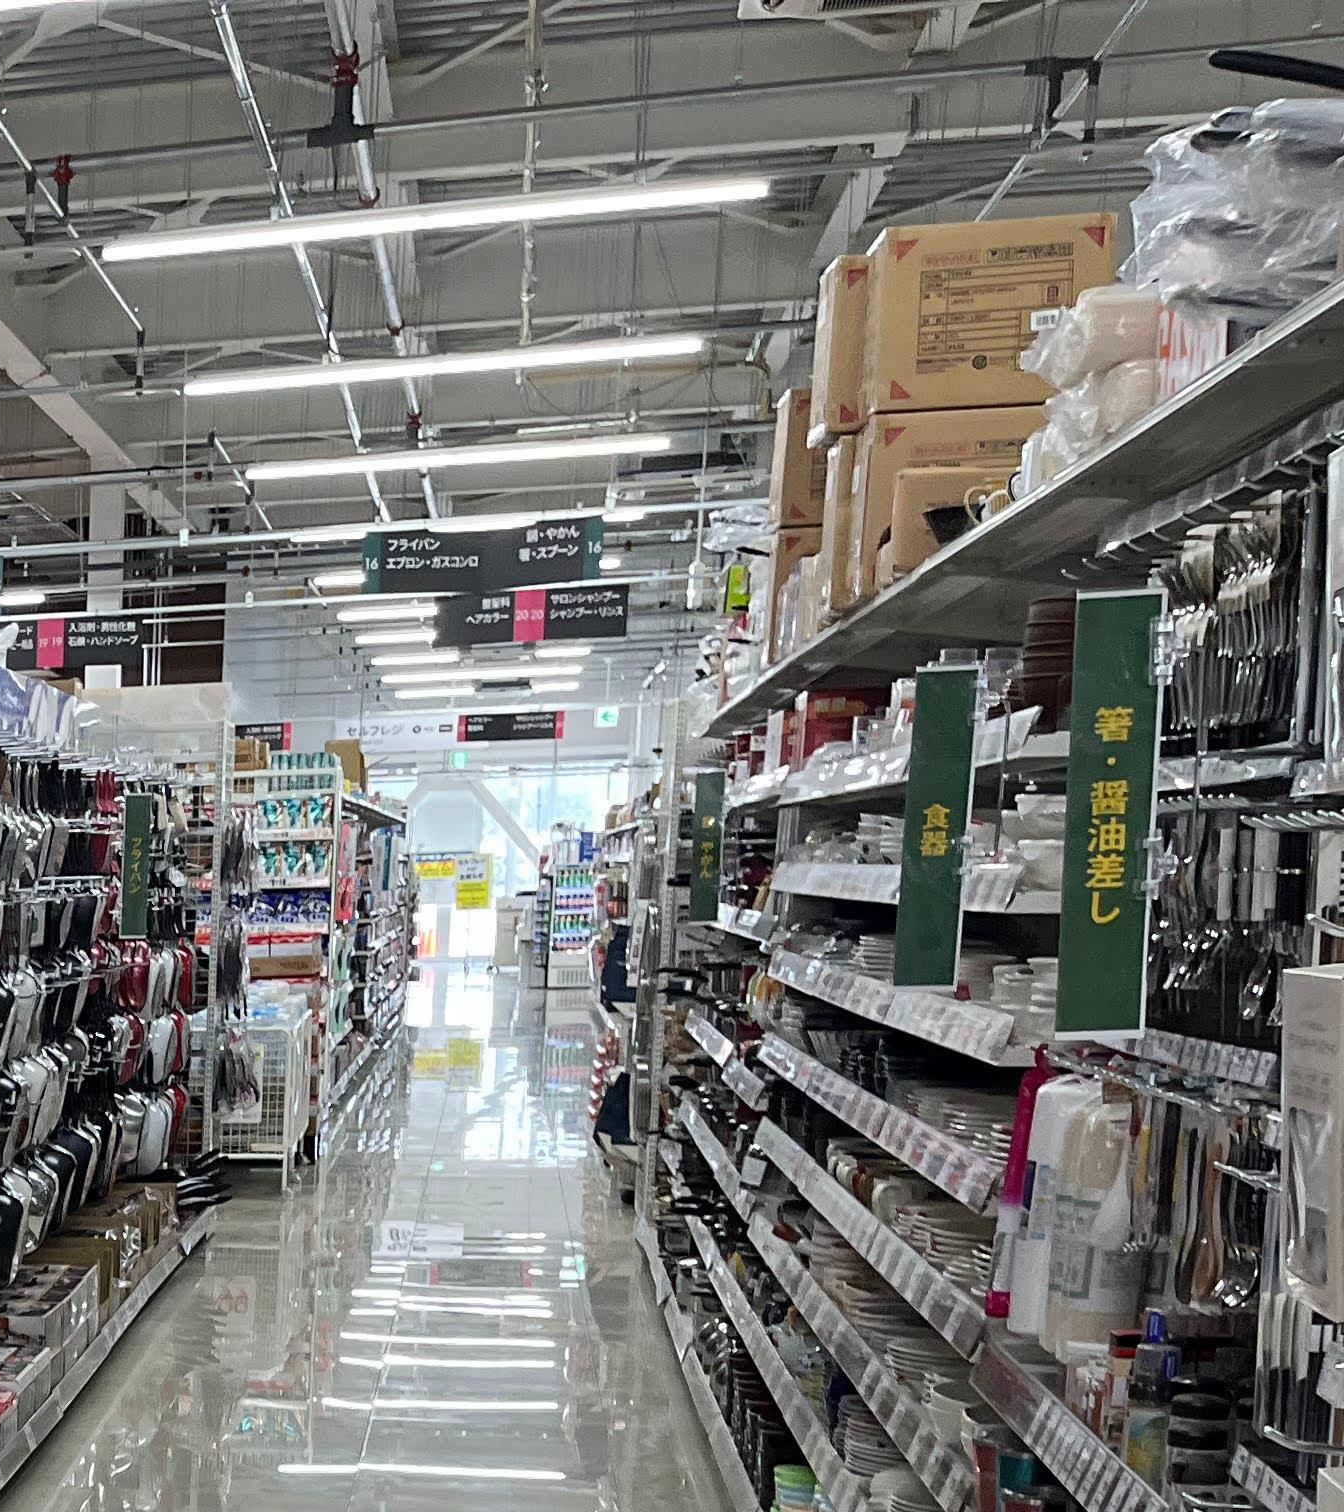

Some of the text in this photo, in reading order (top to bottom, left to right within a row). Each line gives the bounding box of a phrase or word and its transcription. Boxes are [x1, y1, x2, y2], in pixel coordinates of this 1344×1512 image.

[388, 539, 440, 550] フライパン
[588, 541, 601, 554] 16
[365, 558, 378, 570] 16
[386, 556, 479, 569] エプロン・ガスコンロ
[466, 613, 509, 624] ヘアカラー
[515, 611, 543, 620] 20 20
[52, 636, 62, 646] 19
[347, 725, 404, 736] セルフレジ
[1085, 706, 1134, 925] 箸・醤油差し
[920, 803, 951, 858] 食器
